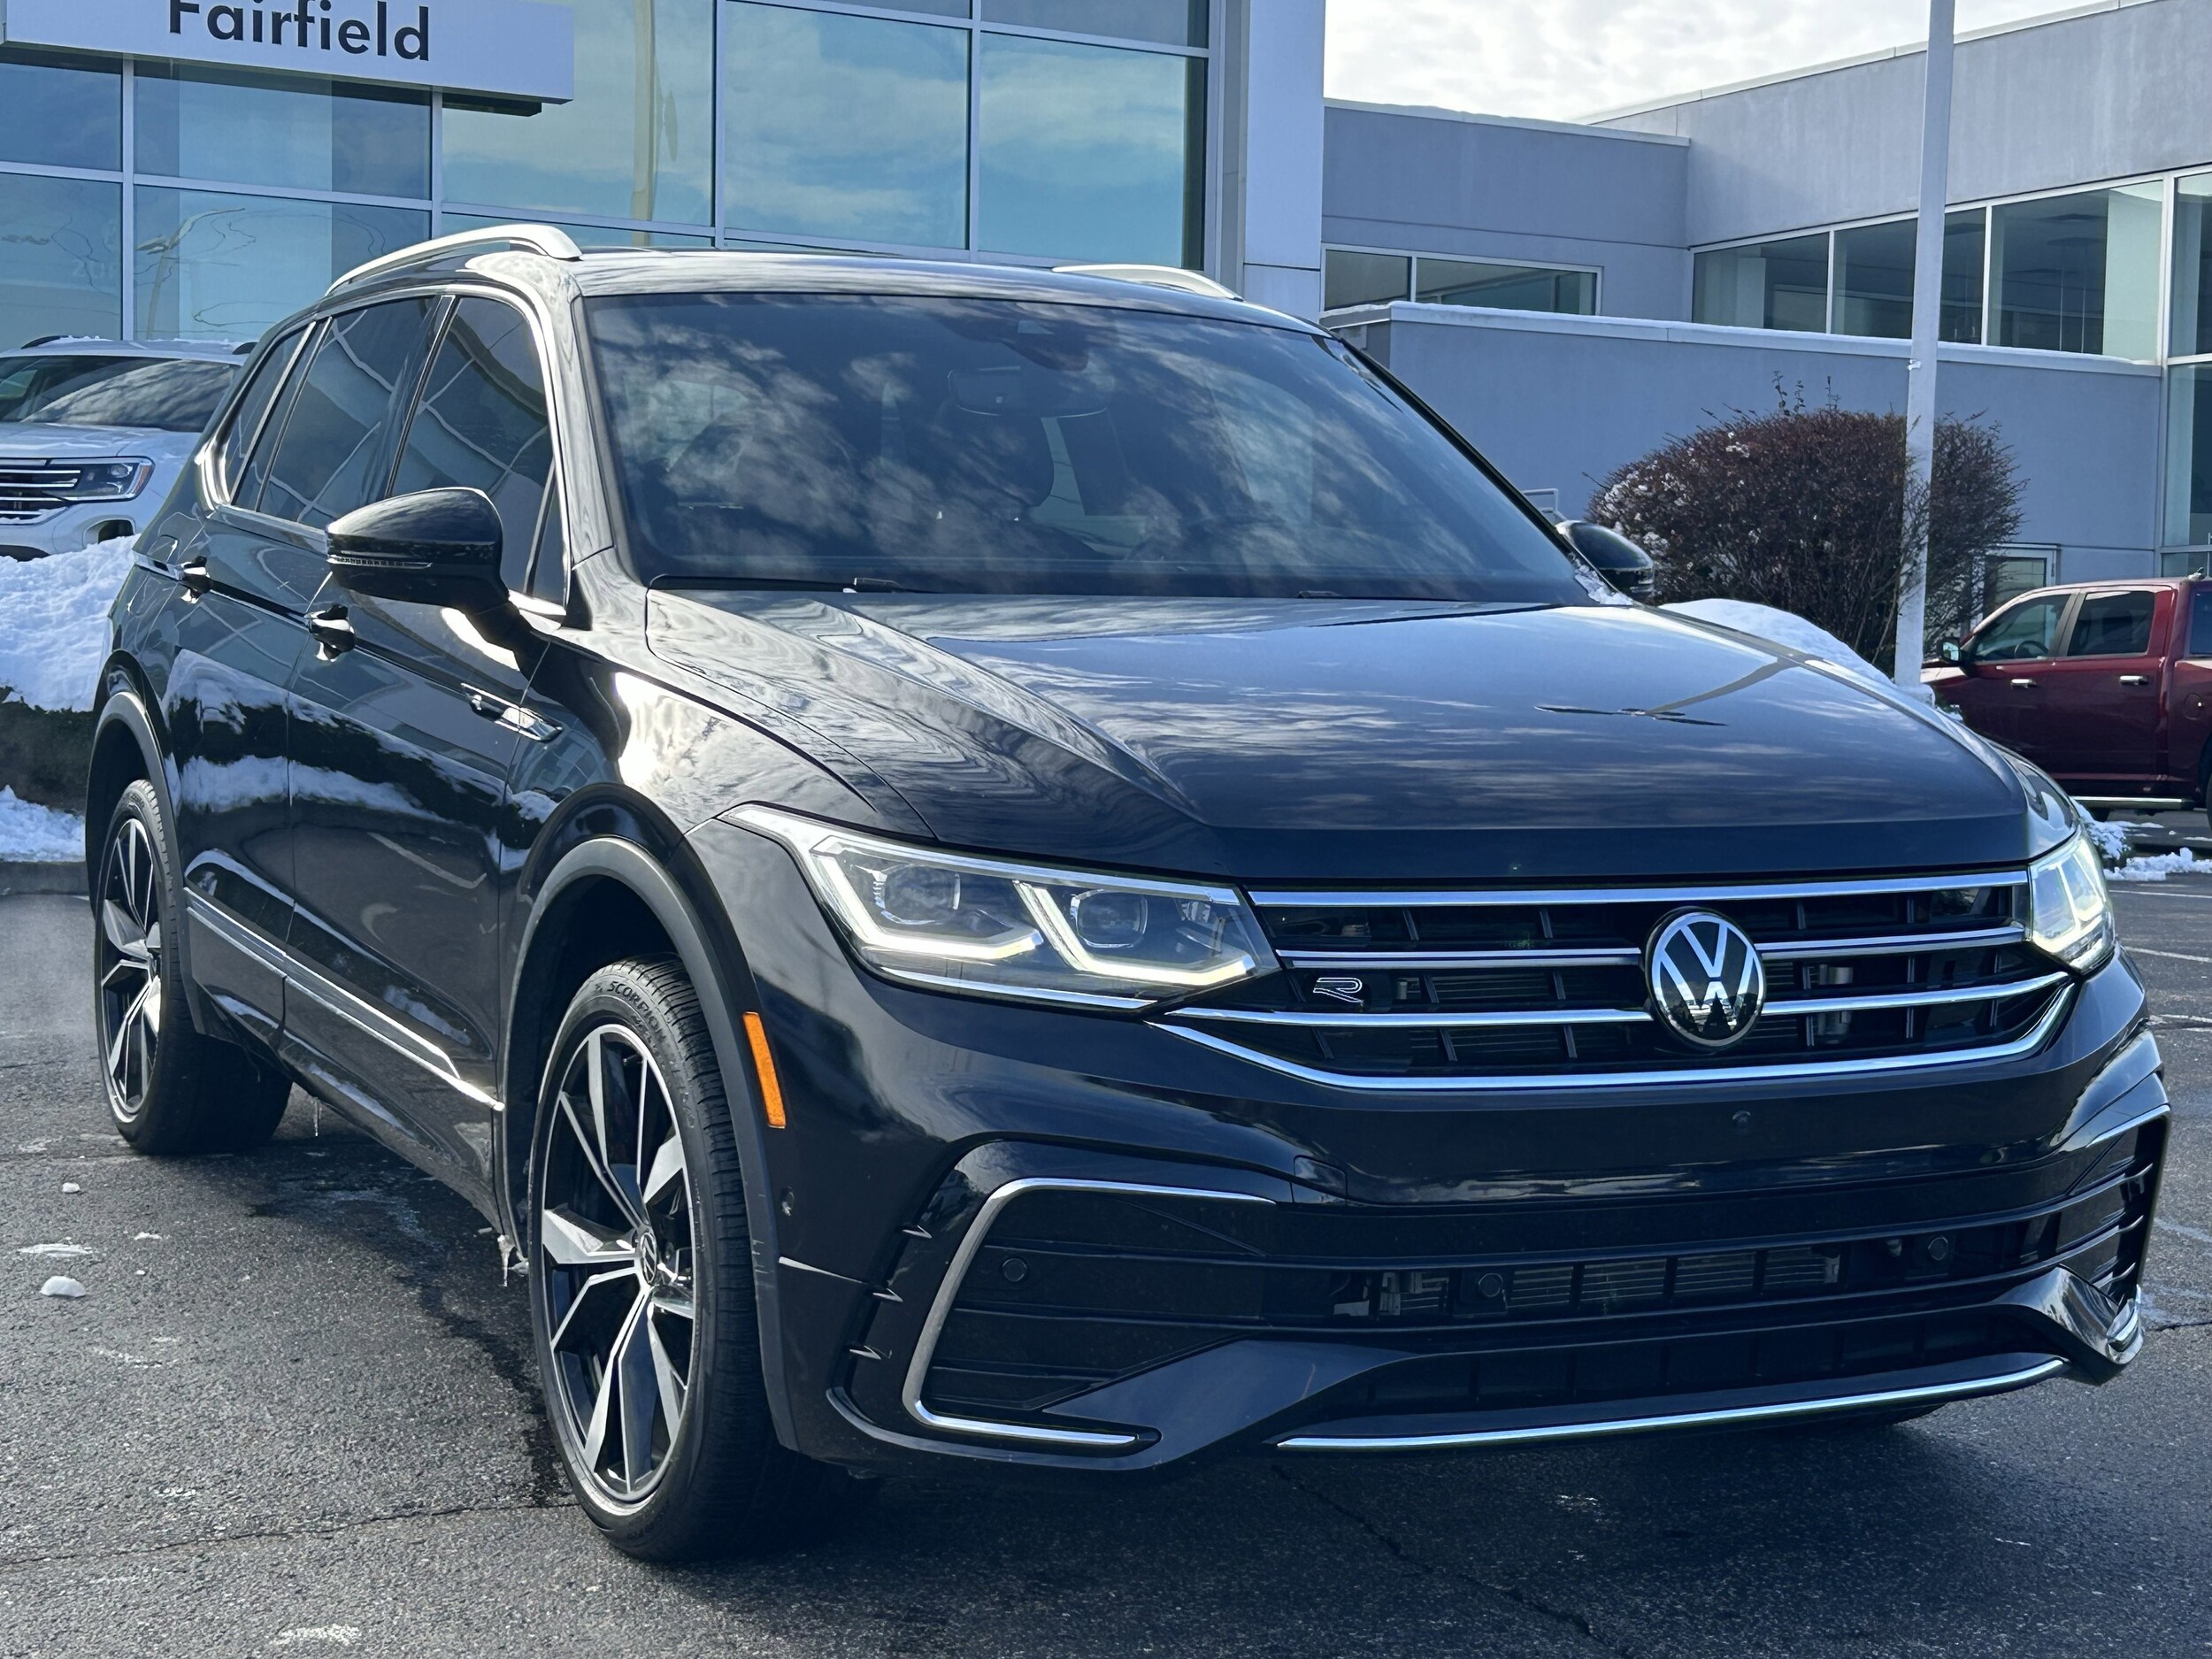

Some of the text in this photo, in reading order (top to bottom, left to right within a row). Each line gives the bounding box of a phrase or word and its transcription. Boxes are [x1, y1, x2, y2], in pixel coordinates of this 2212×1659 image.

[169, 0, 429, 61] Fairfield
[607, 980, 665, 1042] SCORPION
[1313, 977, 1363, 1004] R
